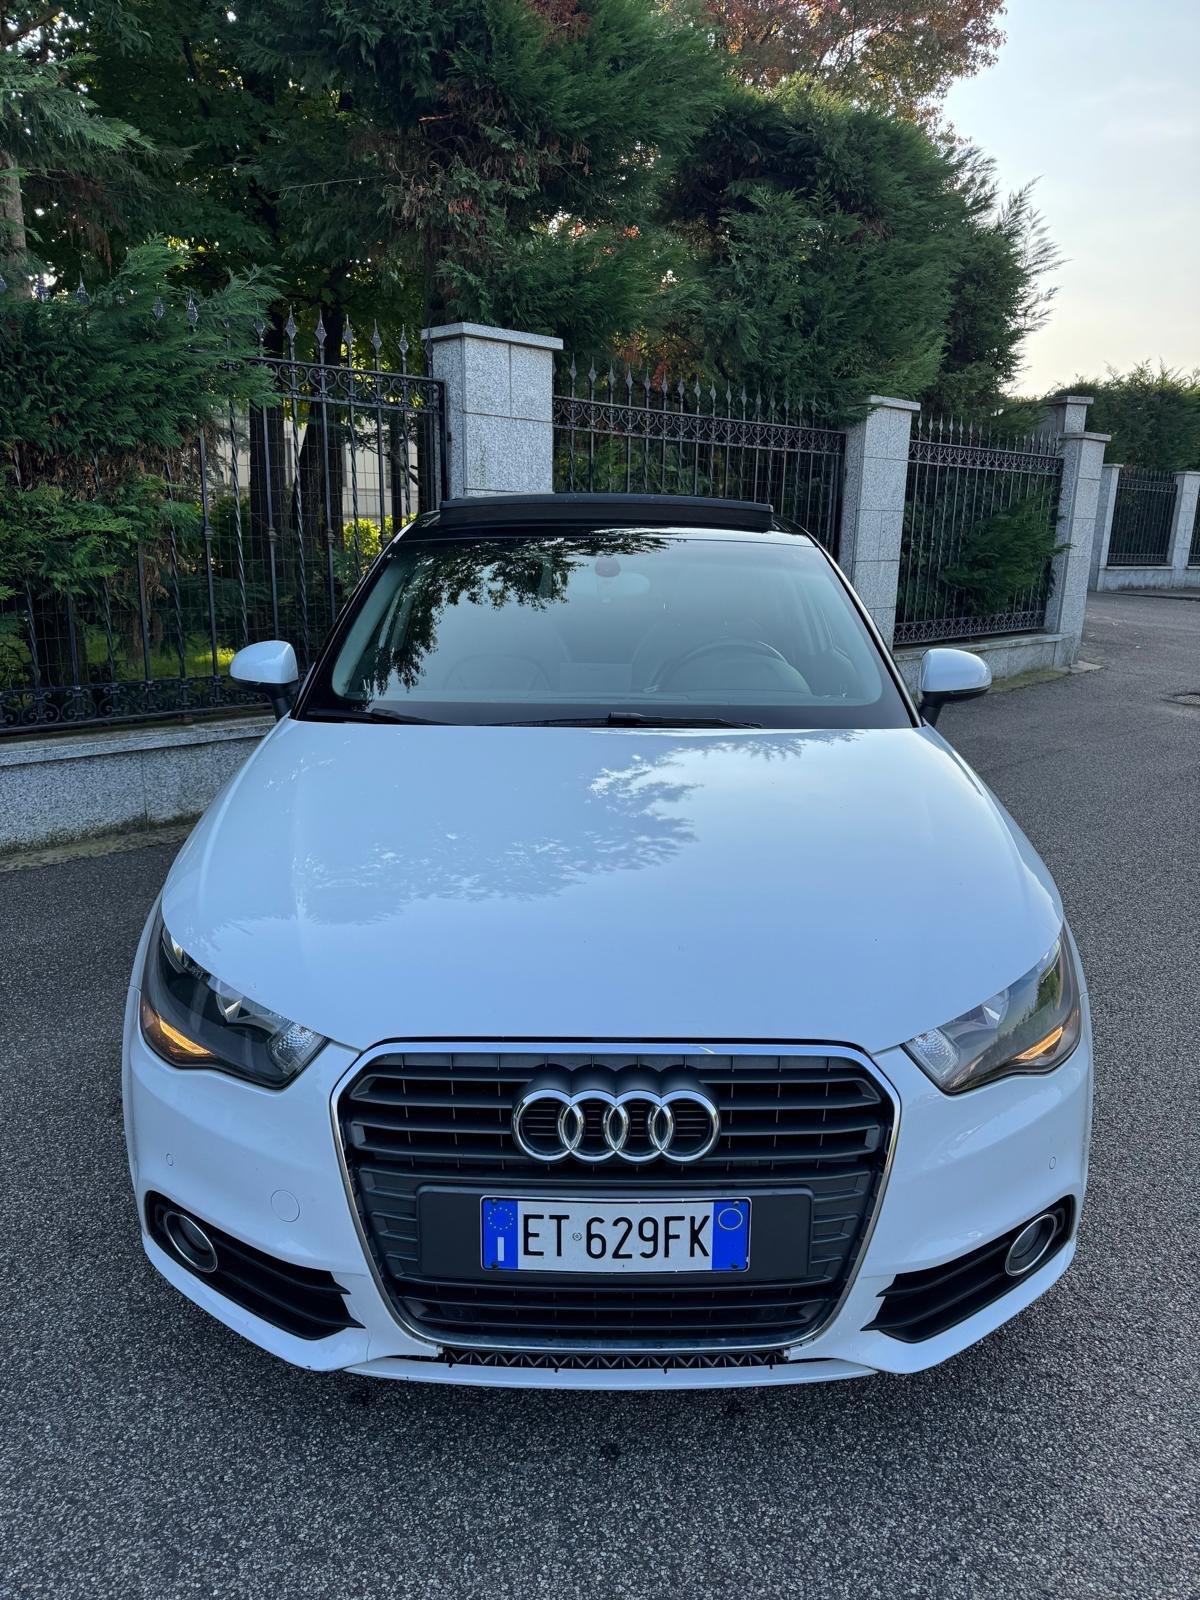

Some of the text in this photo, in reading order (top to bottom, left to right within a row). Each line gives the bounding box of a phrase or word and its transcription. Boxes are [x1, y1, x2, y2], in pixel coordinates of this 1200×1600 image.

[497, 1236, 505, 1262] I
[523, 1214, 710, 1259] ET 629FK
